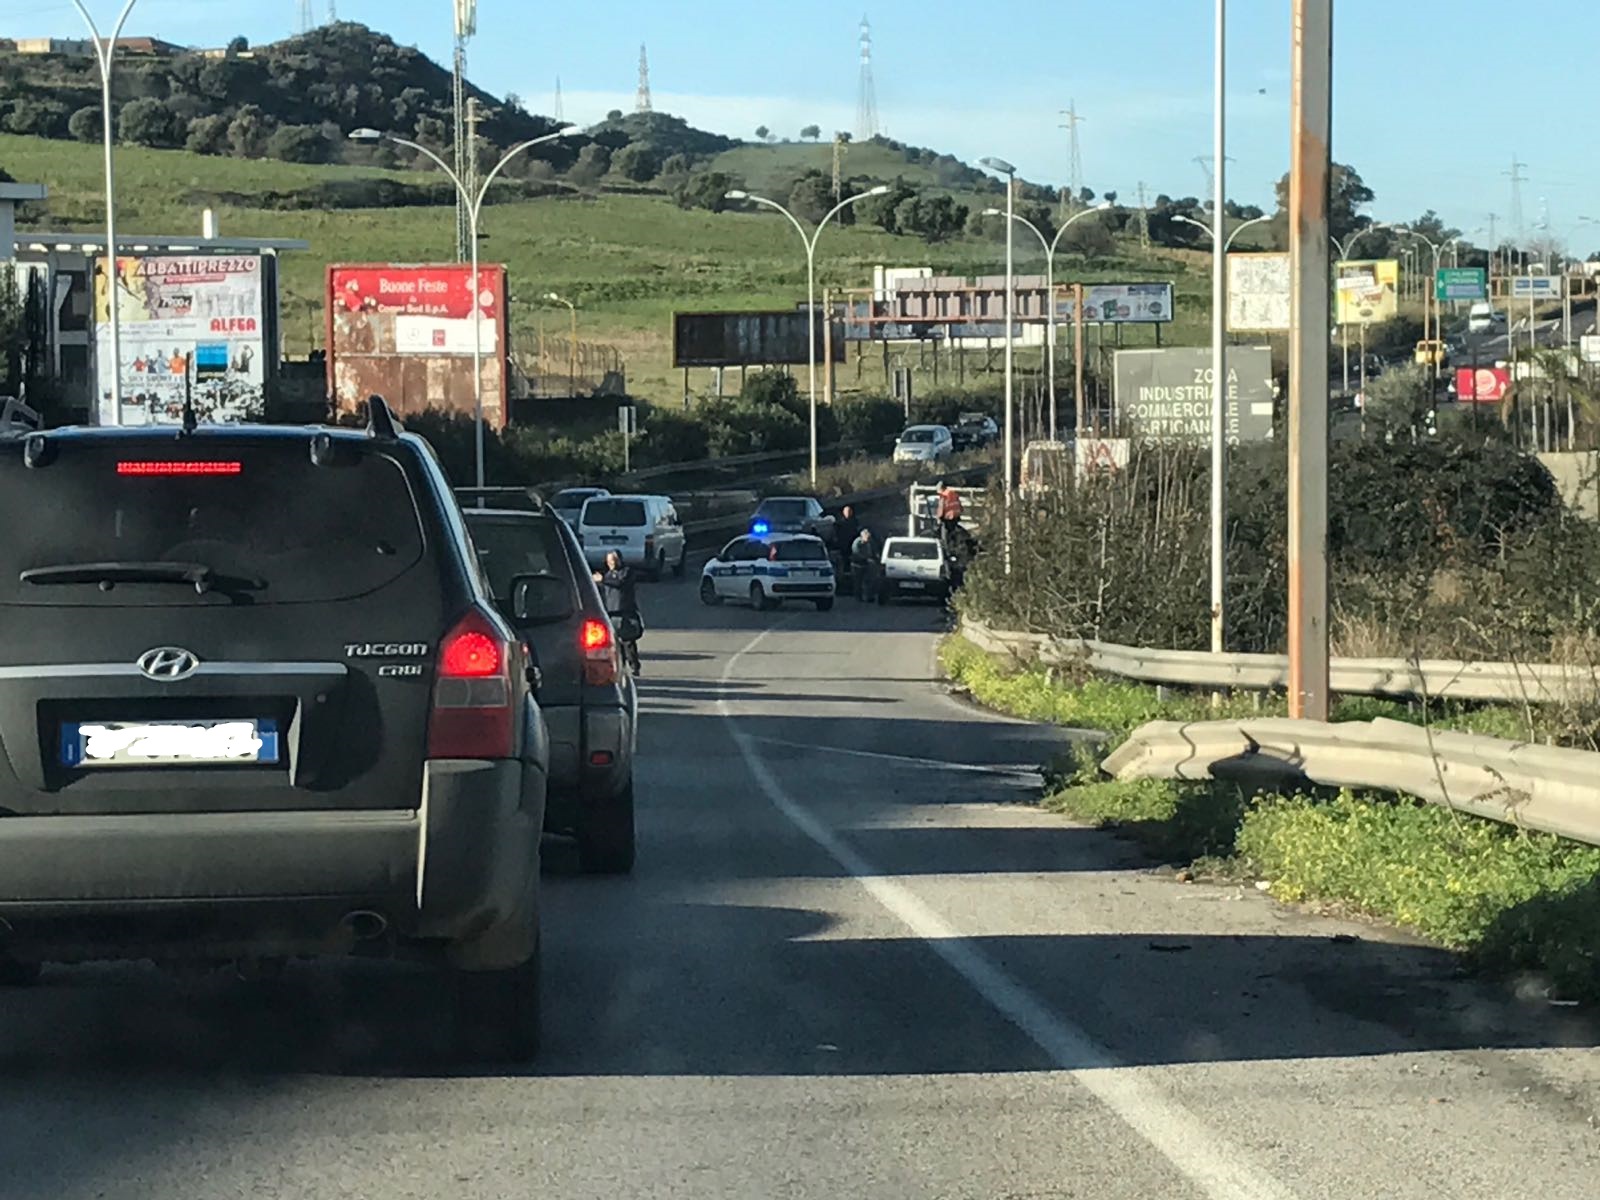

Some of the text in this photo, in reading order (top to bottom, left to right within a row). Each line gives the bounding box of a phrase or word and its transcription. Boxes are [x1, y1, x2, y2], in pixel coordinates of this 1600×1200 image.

[136, 259, 256, 276] ABBATTIPREZZO
[379, 278, 448, 293] Buone Feste
[1194, 368, 1238, 383] ZOA
[1140, 385, 1239, 401] INDUSTRIAE
[1126, 402, 1239, 418] COMMERCIAE
[1140, 419, 1240, 434] ARTIGIANE
[344, 643, 428, 657] TUCSON
